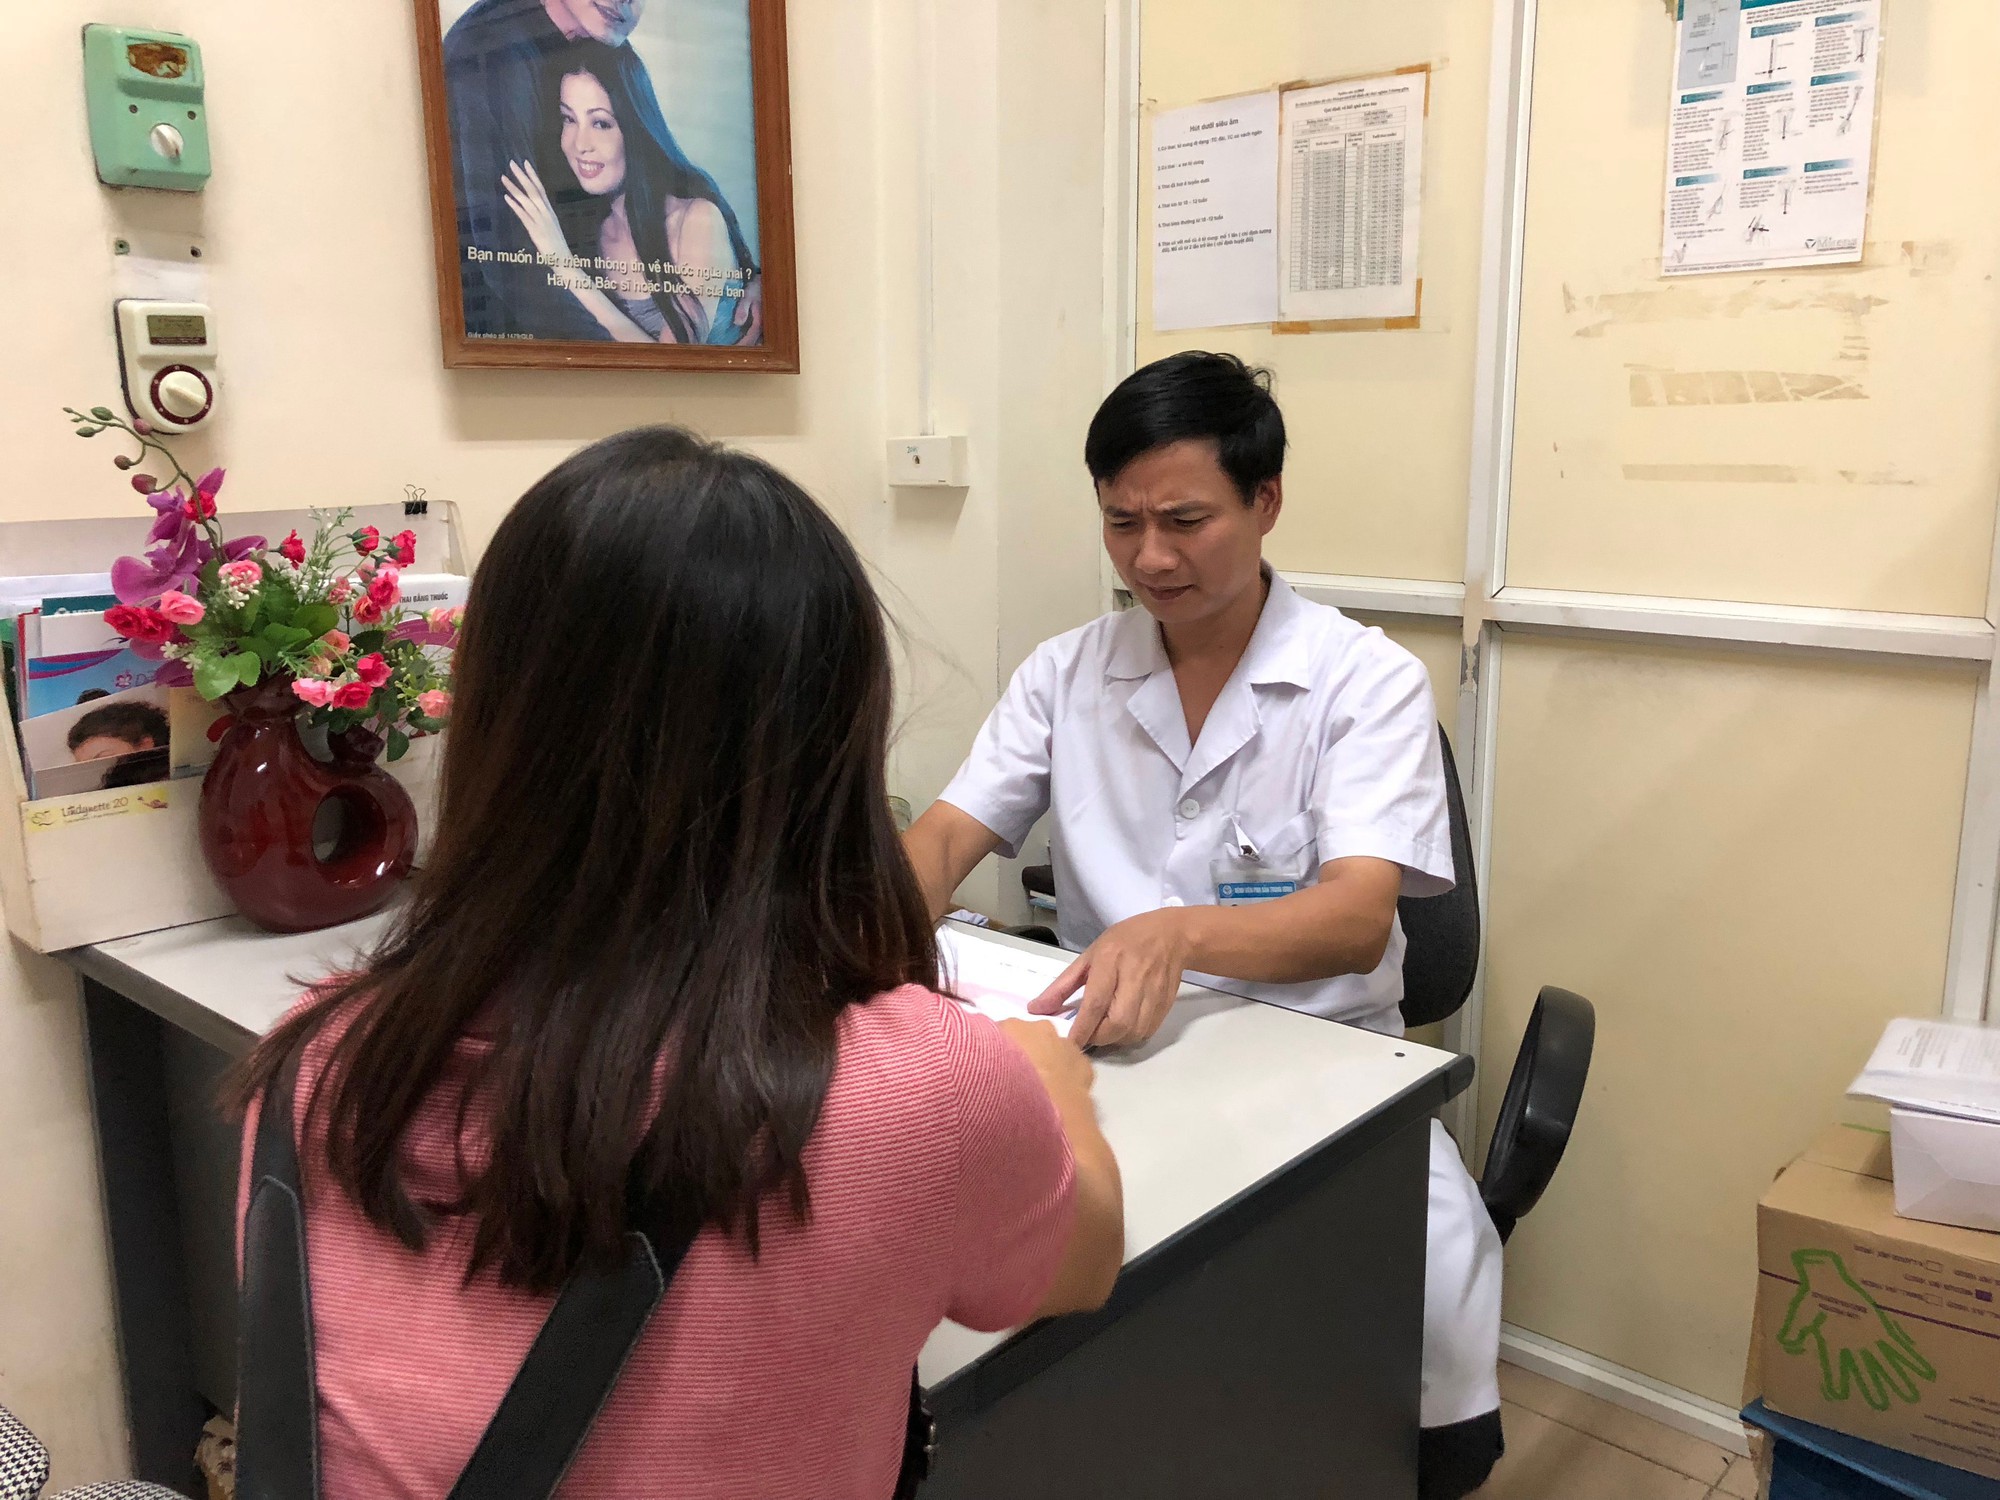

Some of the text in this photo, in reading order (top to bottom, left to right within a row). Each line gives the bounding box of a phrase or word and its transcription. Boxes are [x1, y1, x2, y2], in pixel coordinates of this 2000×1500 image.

[467, 246, 493, 263] Bạn
[497, 248, 532, 264] muốn
[536, 252, 560, 268] biết
[563, 254, 591, 269] thêm
[594, 256, 627, 274] thông
[648, 258, 661, 273] về
[663, 262, 694, 277] thuốc
[745, 268, 752, 280] ?
[547, 273, 570, 290] Hãy
[595, 276, 618, 290] Bác
[621, 280, 631, 293] sĩ
[633, 280, 661, 294] hoặc
[663, 281, 691, 297] Dược
[693, 284, 704, 297] sĩ
[726, 286, 745, 300] bạn
[61, 802, 111, 817] Lindynette
[112, 796, 129, 809] 20
